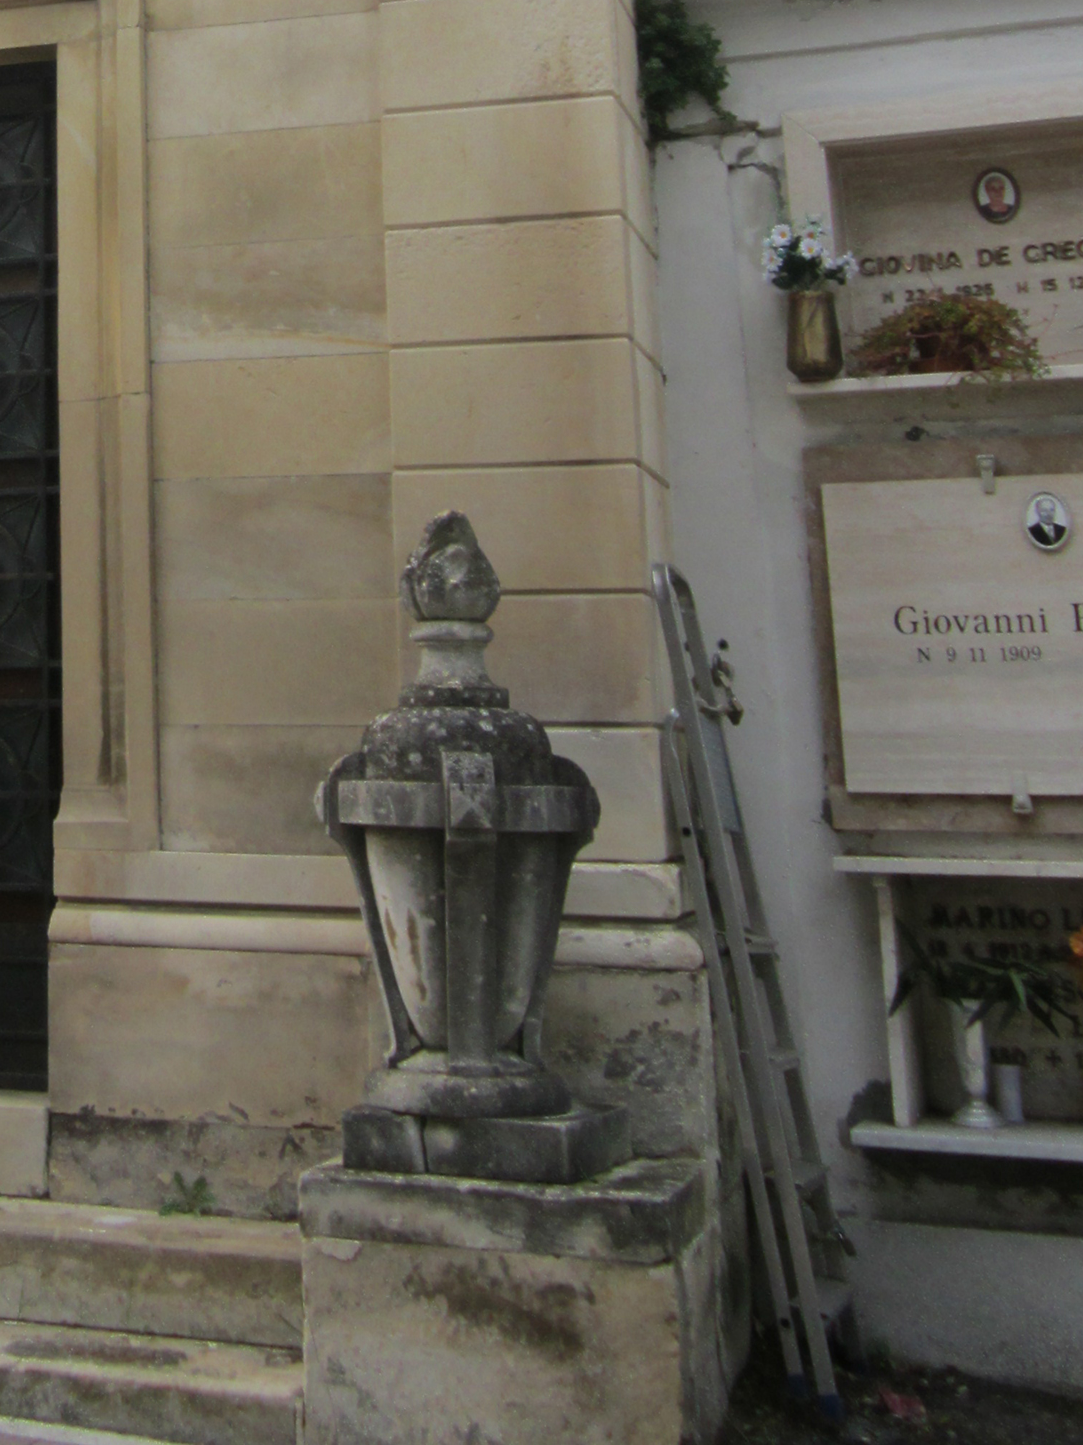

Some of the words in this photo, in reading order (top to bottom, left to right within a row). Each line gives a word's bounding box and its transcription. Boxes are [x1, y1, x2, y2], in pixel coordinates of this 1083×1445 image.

[858, 251, 963, 276] GIOVINA
[976, 245, 1012, 268] DE
[1040, 278, 1058, 292] 15
[893, 605, 1049, 635] Giovanni
[916, 646, 931, 663] N
[946, 646, 957, 662] 9
[969, 646, 987, 663] 11
[1000, 645, 1042, 662] 1909
[927, 902, 1051, 930] MARINO
